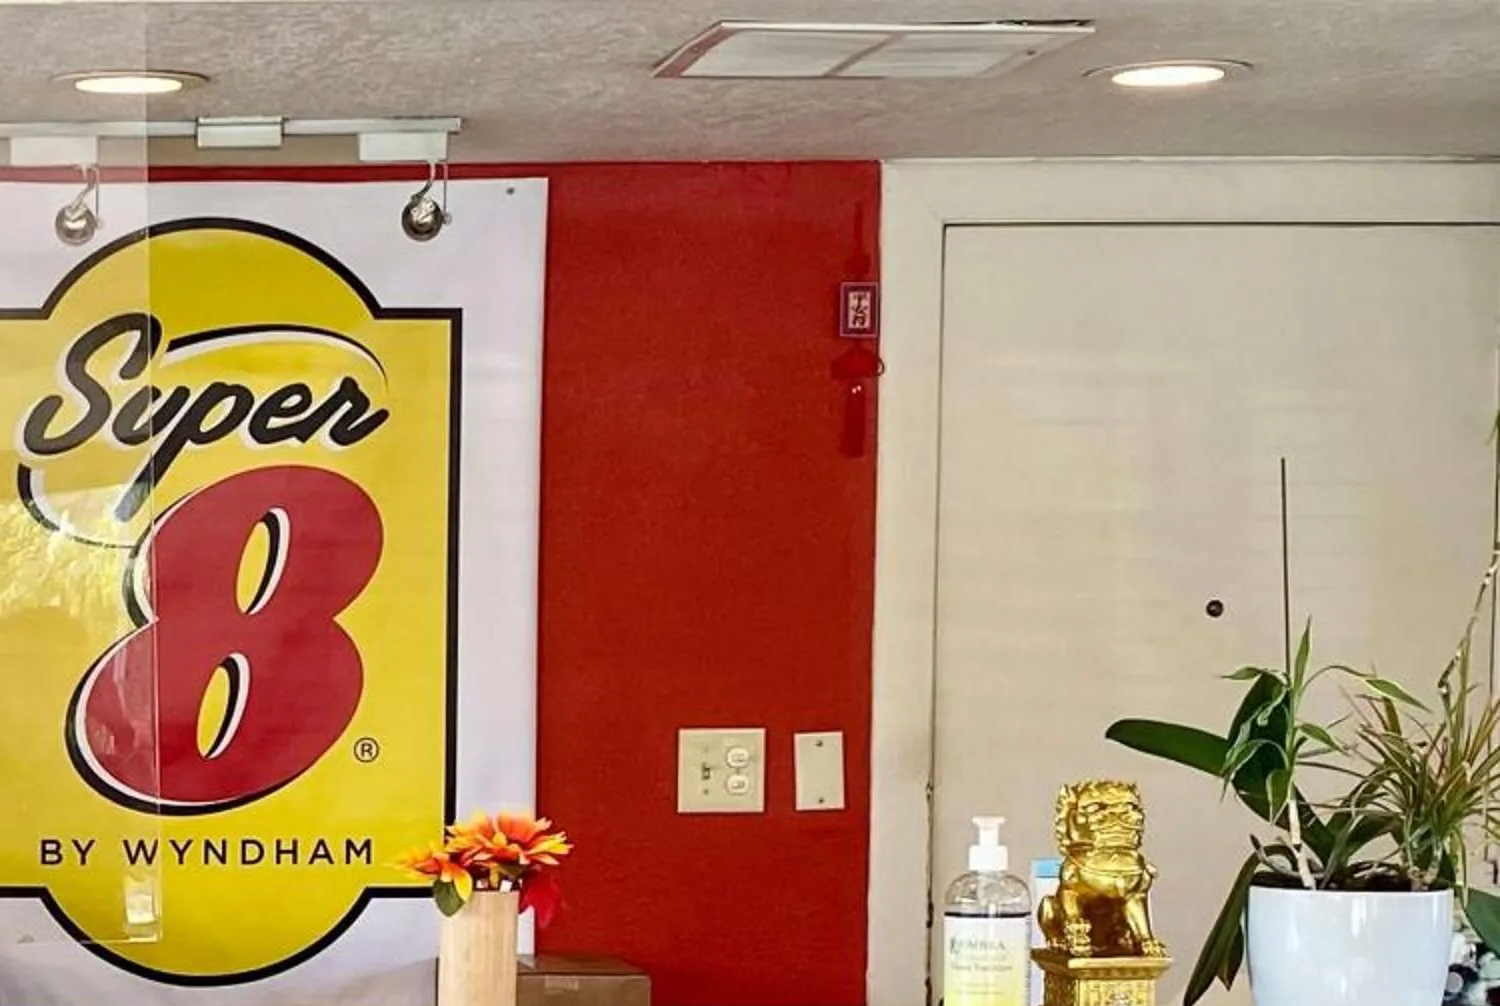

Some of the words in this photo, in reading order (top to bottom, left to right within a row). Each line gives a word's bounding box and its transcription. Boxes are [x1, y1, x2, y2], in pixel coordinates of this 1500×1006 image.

[22, 311, 390, 523] Super
[65, 464, 385, 817] 8
[39, 838, 96, 866] BY
[122, 838, 373, 866] WYNDHAM
